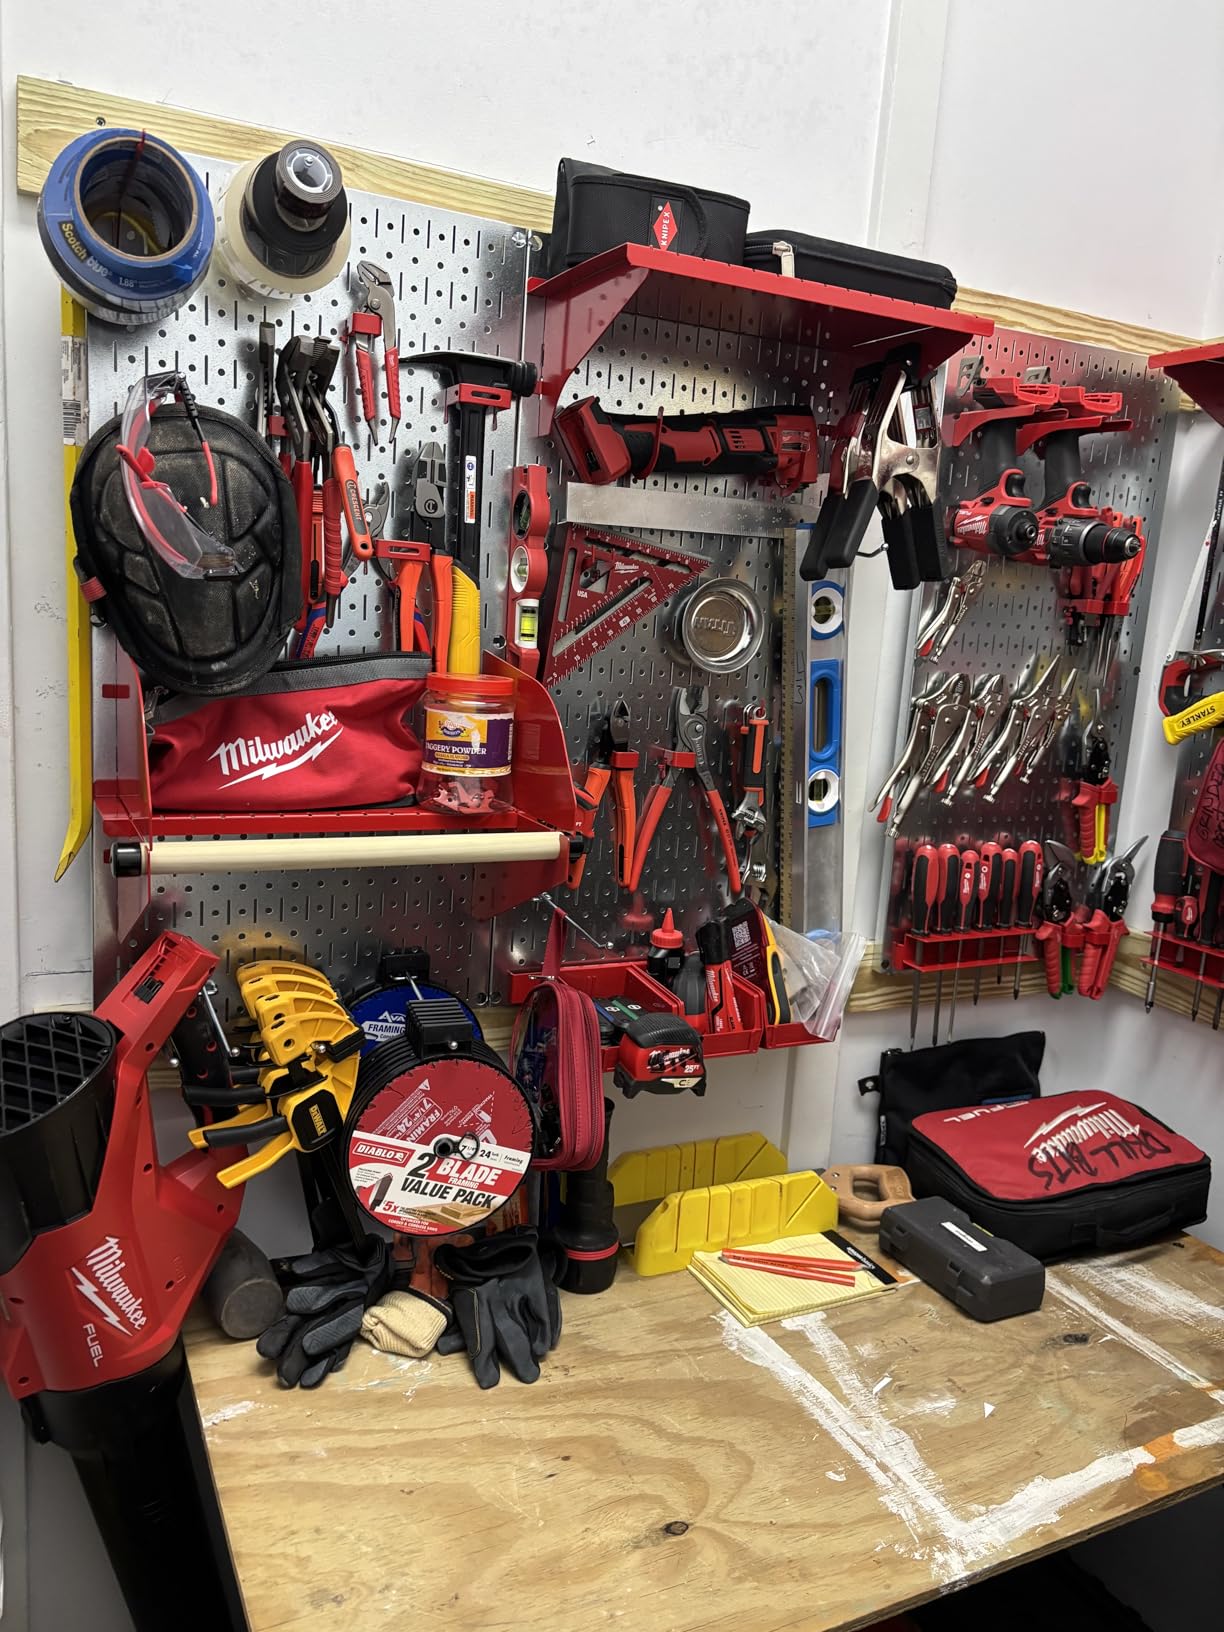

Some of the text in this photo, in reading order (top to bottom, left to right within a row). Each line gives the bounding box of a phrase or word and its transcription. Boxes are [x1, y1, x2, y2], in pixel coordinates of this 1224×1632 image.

[61, 222, 87, 260] Scotch
[660, 211, 671, 246] KNIPEX
[349, 486, 362, 520] CRESCENT
[576, 590, 588, 599] USA
[1180, 705, 1216, 728] STANLEY
[206, 710, 339, 776] Milwaukee
[452, 746, 487, 755] POWDER
[367, 1023, 406, 1035] FRAMING
[406, 1109, 441, 1143] FRAMIN
[1030, 1109, 1140, 1164] Milwaukee
[356, 1143, 395, 1160] DIABLO
[479, 1149, 492, 1159] 24
[503, 1154, 524, 1165] Framing
[406, 1152, 437, 1180] 2
[436, 1158, 502, 1186] BLADE
[447, 1176, 480, 1190] FRAMING
[382, 1200, 399, 1214] 5x
[400, 1177, 498, 1209] VALUE PACK
[85, 1236, 148, 1330] Milwaukee
[83, 1322, 104, 1368] FUEL
